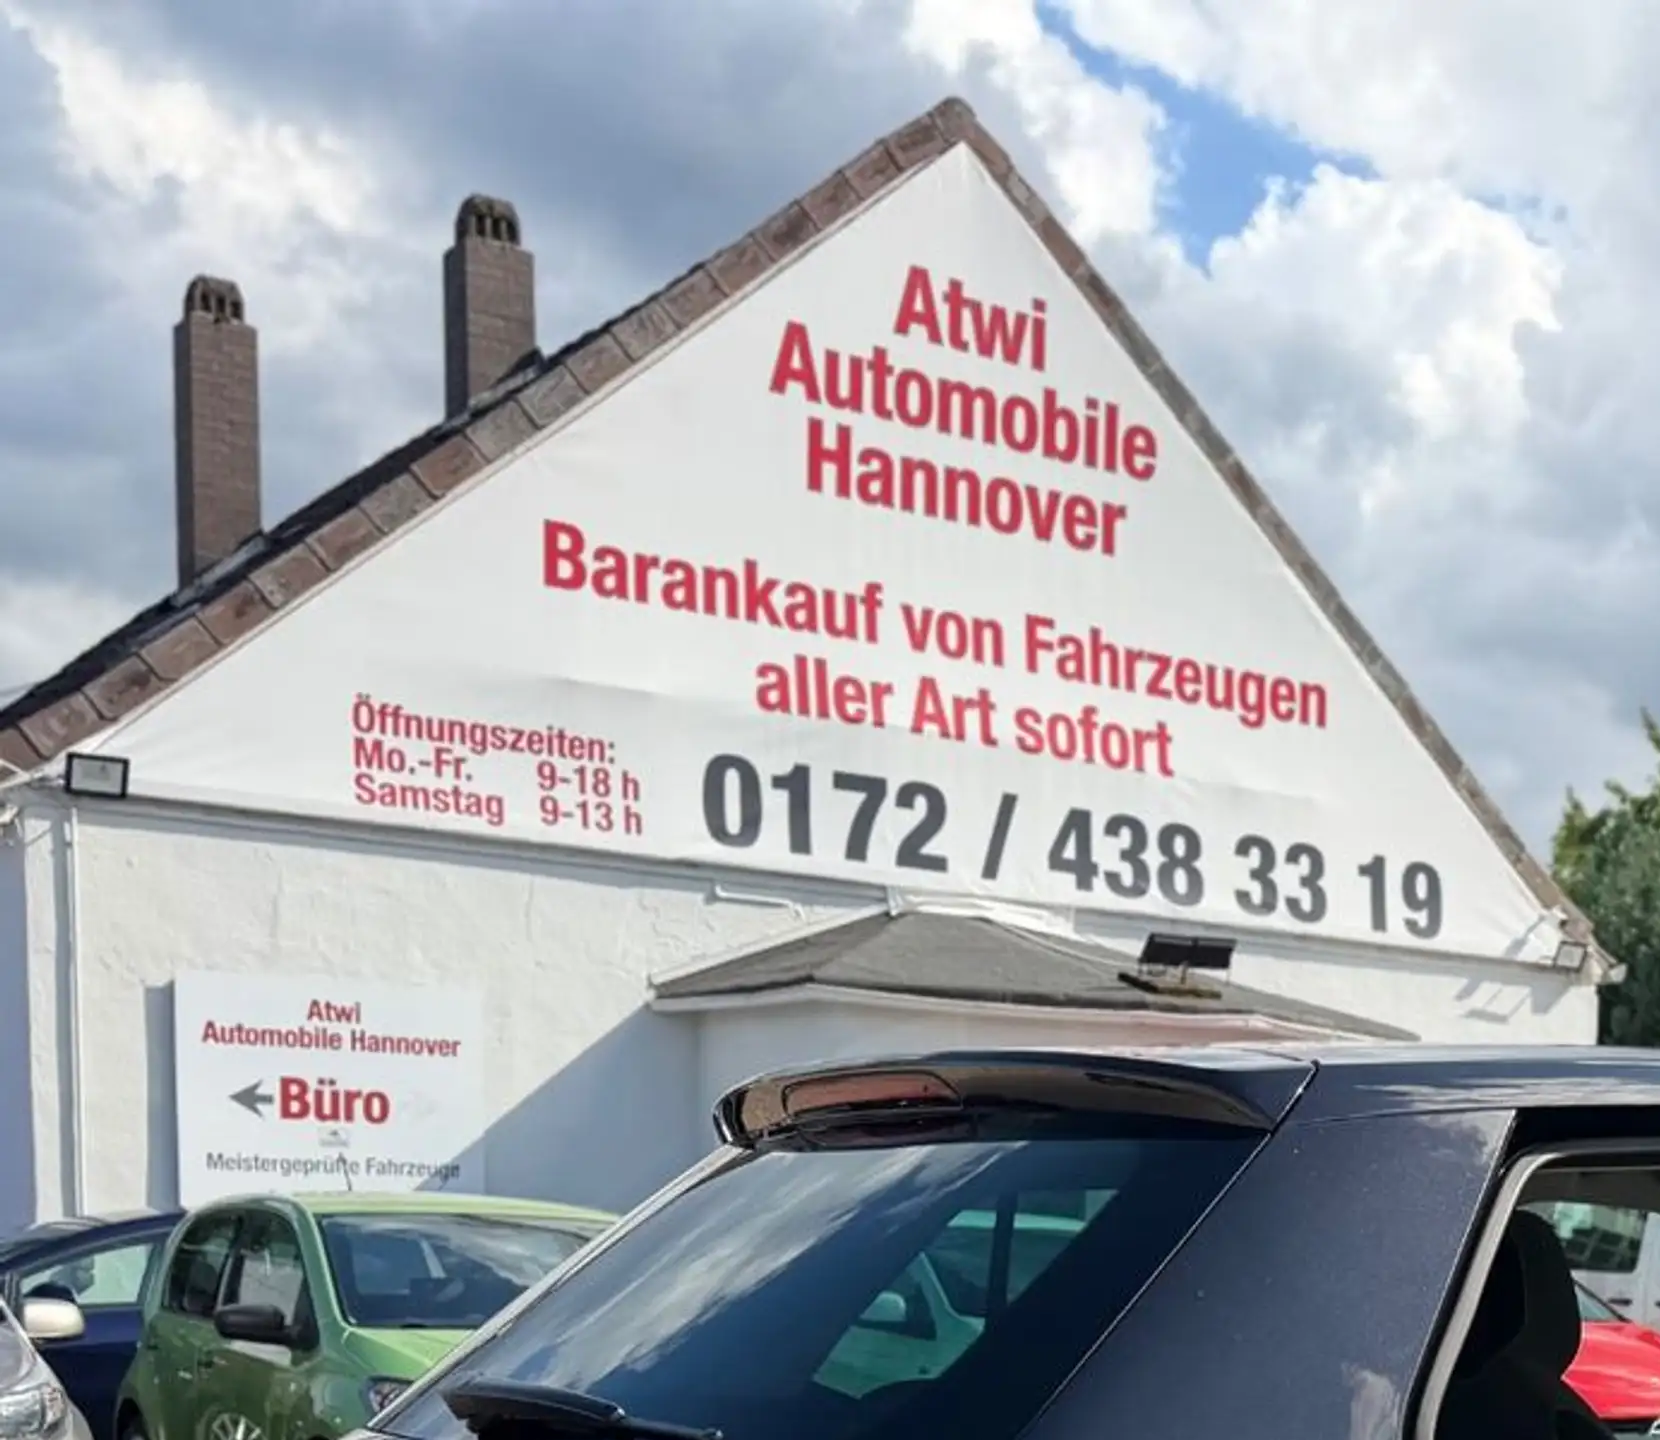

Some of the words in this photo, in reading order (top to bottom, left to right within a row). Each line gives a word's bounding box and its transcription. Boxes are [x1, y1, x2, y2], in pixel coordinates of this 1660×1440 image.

[894, 265, 1048, 373] Atwi
[770, 318, 1158, 481] Automobile
[806, 415, 1127, 557] Hannover
[541, 519, 884, 646] Barankauf
[901, 604, 1005, 669] von
[1024, 614, 1328, 729] Fahrzeugen
[351, 692, 616, 765] Öffnungszeiten:
[754, 655, 895, 729] aller
[911, 676, 997, 748] Art
[1013, 704, 1174, 779] sofort
[352, 737, 474, 783] Mo.-Fr.
[536, 760, 612, 799] 9-18
[621, 770, 641, 801] h
[354, 772, 505, 827] Samstag
[539, 794, 614, 832] 9-13
[624, 805, 643, 835] h
[703, 754, 947, 872] 0172
[982, 793, 1018, 880] /
[1048, 808, 1203, 904] 438
[1235, 835, 1326, 922] 33
[1358, 855, 1441, 938] 19
[201, 1020, 342, 1052] Automobile
[349, 1029, 462, 1057] Hannover
[306, 998, 362, 1025] Atwi
[278, 1075, 391, 1125] Büro
[365, 1156, 461, 1182] Fahrzeuge
